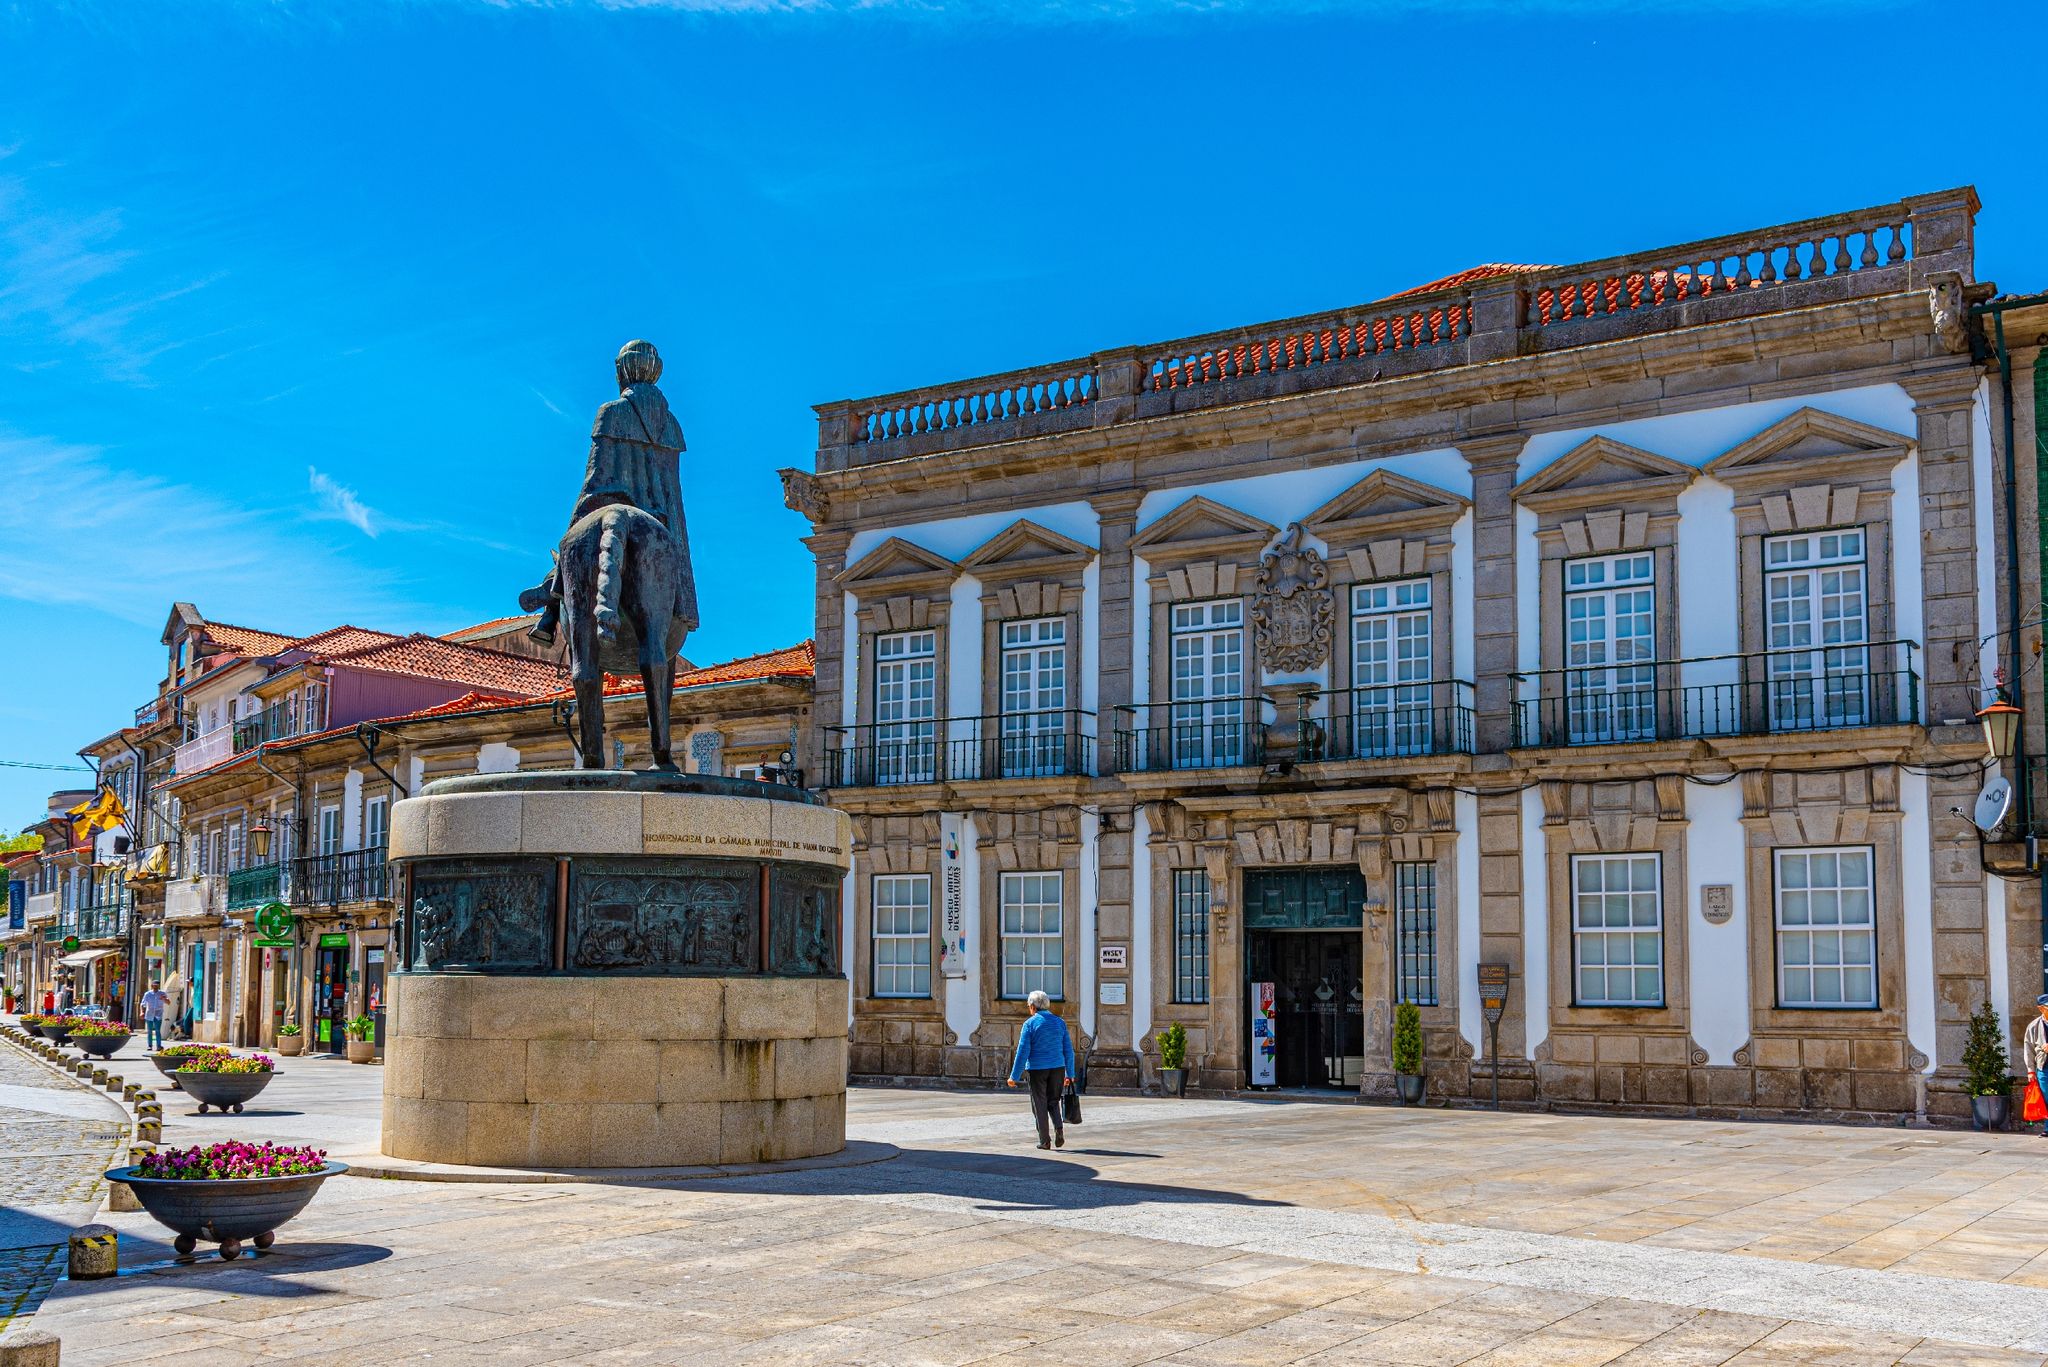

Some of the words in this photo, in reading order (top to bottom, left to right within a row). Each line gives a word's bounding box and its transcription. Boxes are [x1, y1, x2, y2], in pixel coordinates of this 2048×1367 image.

[1986, 788, 2005, 803] NOS
[645, 833, 702, 844] HOMENAGEM
[705, 835, 716, 845] DA
[719, 835, 752, 846] CÂMARA
[754, 838, 791, 849] MUNICIPAL
[792, 841, 801, 850] DE
